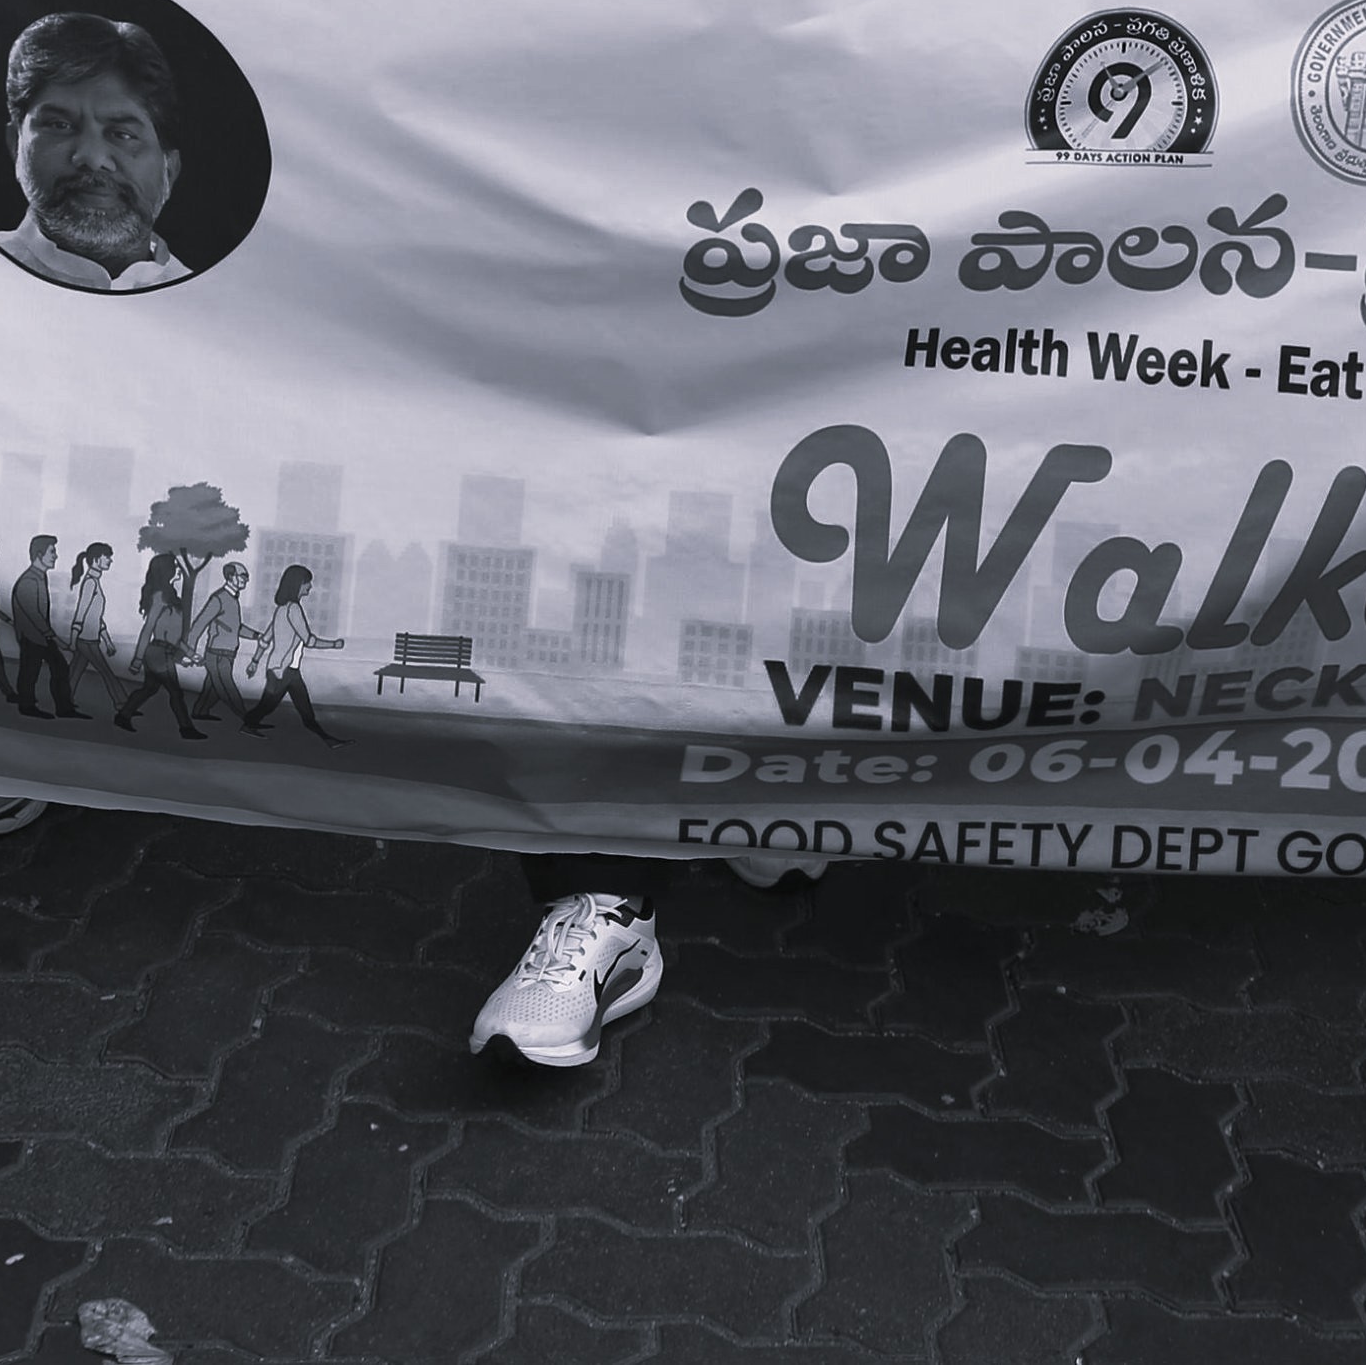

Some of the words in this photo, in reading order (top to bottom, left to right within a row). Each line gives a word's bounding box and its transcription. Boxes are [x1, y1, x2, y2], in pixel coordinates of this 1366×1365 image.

[1055, 152, 1070, 161] 99
[1074, 152, 1103, 162] DAYS
[1105, 153, 1151, 163] ACTION
[1154, 154, 1184, 164] PLAN
[678, 185, 932, 317] ప్రజా
[904, 325, 1069, 378] Health
[1087, 331, 1231, 391] Week
[1276, 346, 1362, 399] Eat
[764, 657, 1108, 733] VENUE:
[679, 744, 938, 783] Date:
[874, 819, 1094, 863] SAFETY
[1110, 823, 1260, 873] DEPT
